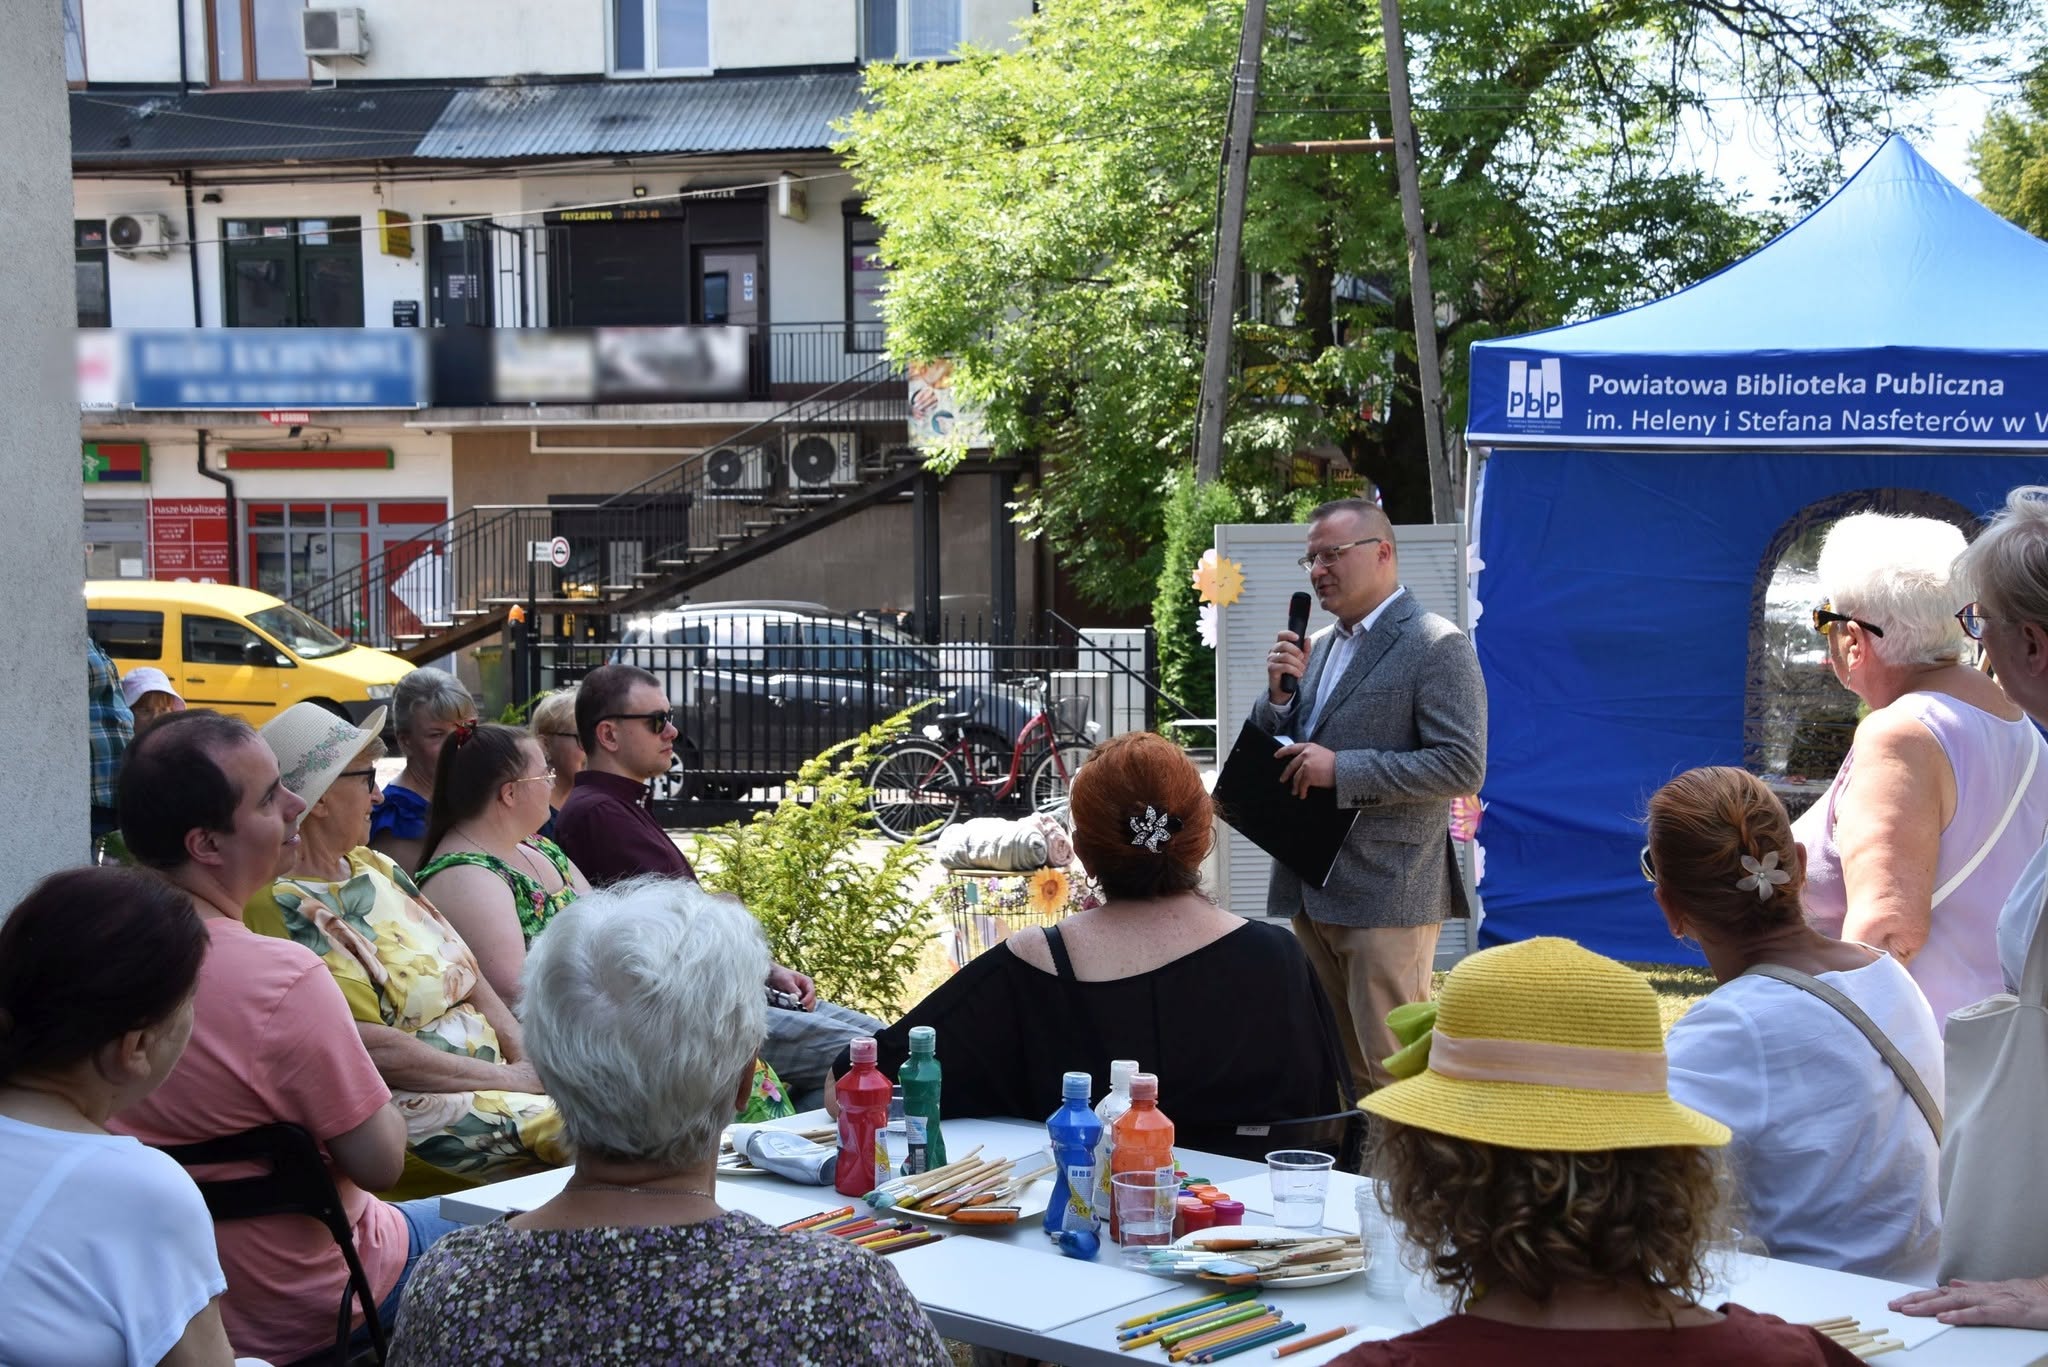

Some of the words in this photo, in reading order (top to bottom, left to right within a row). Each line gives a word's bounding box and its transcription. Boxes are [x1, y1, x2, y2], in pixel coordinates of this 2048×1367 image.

[560, 211, 613, 220] FRYZJERSTWO
[1588, 373, 1727, 395] Powiatowa
[1736, 372, 1866, 395] Biblioteka
[1875, 372, 2005, 396] Publiczna
[1509, 391, 1560, 413] pbp
[1586, 409, 1623, 430] im.
[1632, 409, 1717, 436] Heleny
[1723, 410, 1730, 431] i
[1737, 409, 1832, 431] Stefana
[1841, 408, 1994, 432] Nasfeterów
[2002, 416, 2026, 433] w
[154, 505, 179, 514] nasze
[181, 504, 227, 516] lokalizacje
